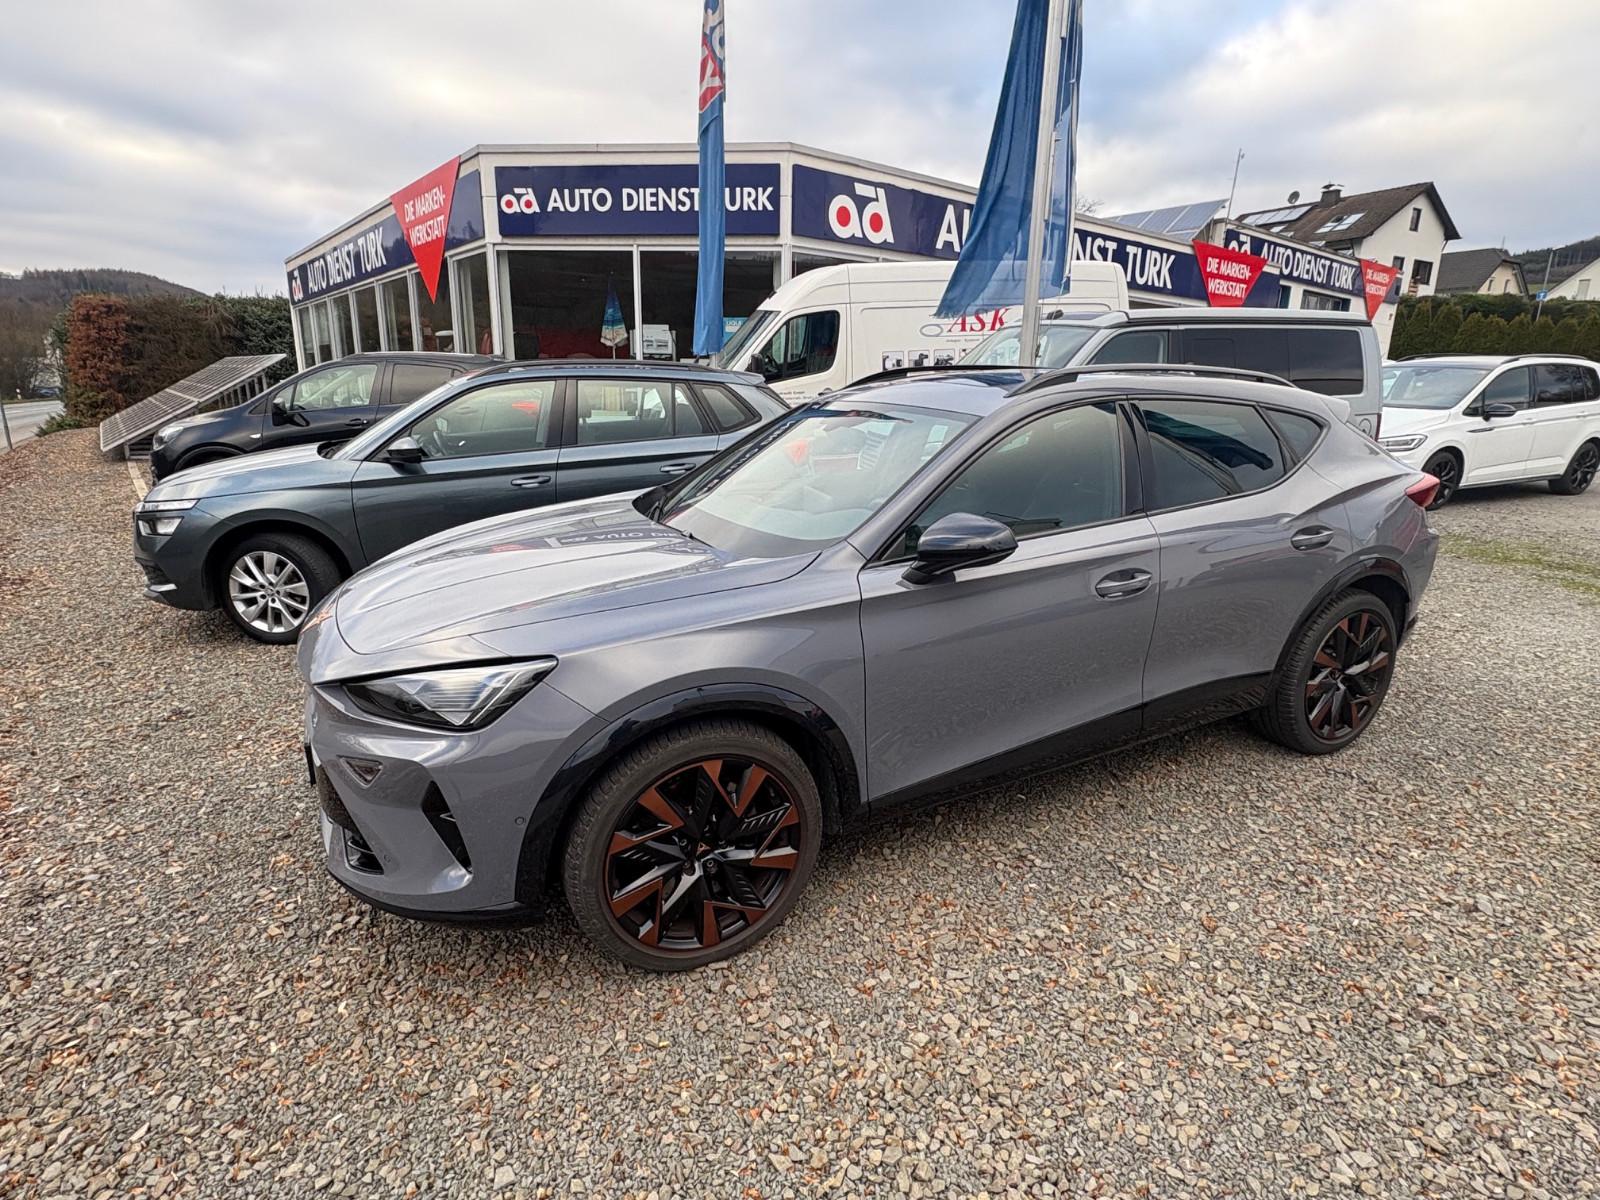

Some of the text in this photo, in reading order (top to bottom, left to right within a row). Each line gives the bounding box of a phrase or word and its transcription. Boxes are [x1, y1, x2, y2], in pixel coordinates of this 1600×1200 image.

[404, 185, 446, 223] DIE MARKEN-
[547, 187, 613, 212] AUTO
[622, 187, 700, 212] DIENST
[724, 186, 774, 211] URK
[409, 214, 445, 248] WERKSTATT
[306, 260, 327, 294] AUTO
[326, 242, 356, 286] DIENST
[357, 226, 386, 273] TURK
[1072, 232, 1176, 289] NST TURK
[1206, 256, 1252, 281] DIE MARKEN-
[1260, 242, 1293, 276] AUTO
[1292, 251, 1332, 284] DIENST
[1330, 261, 1356, 291] TURK
[1208, 277, 1247, 298] WERKSTATT
[947, 307, 1010, 333] ASK
